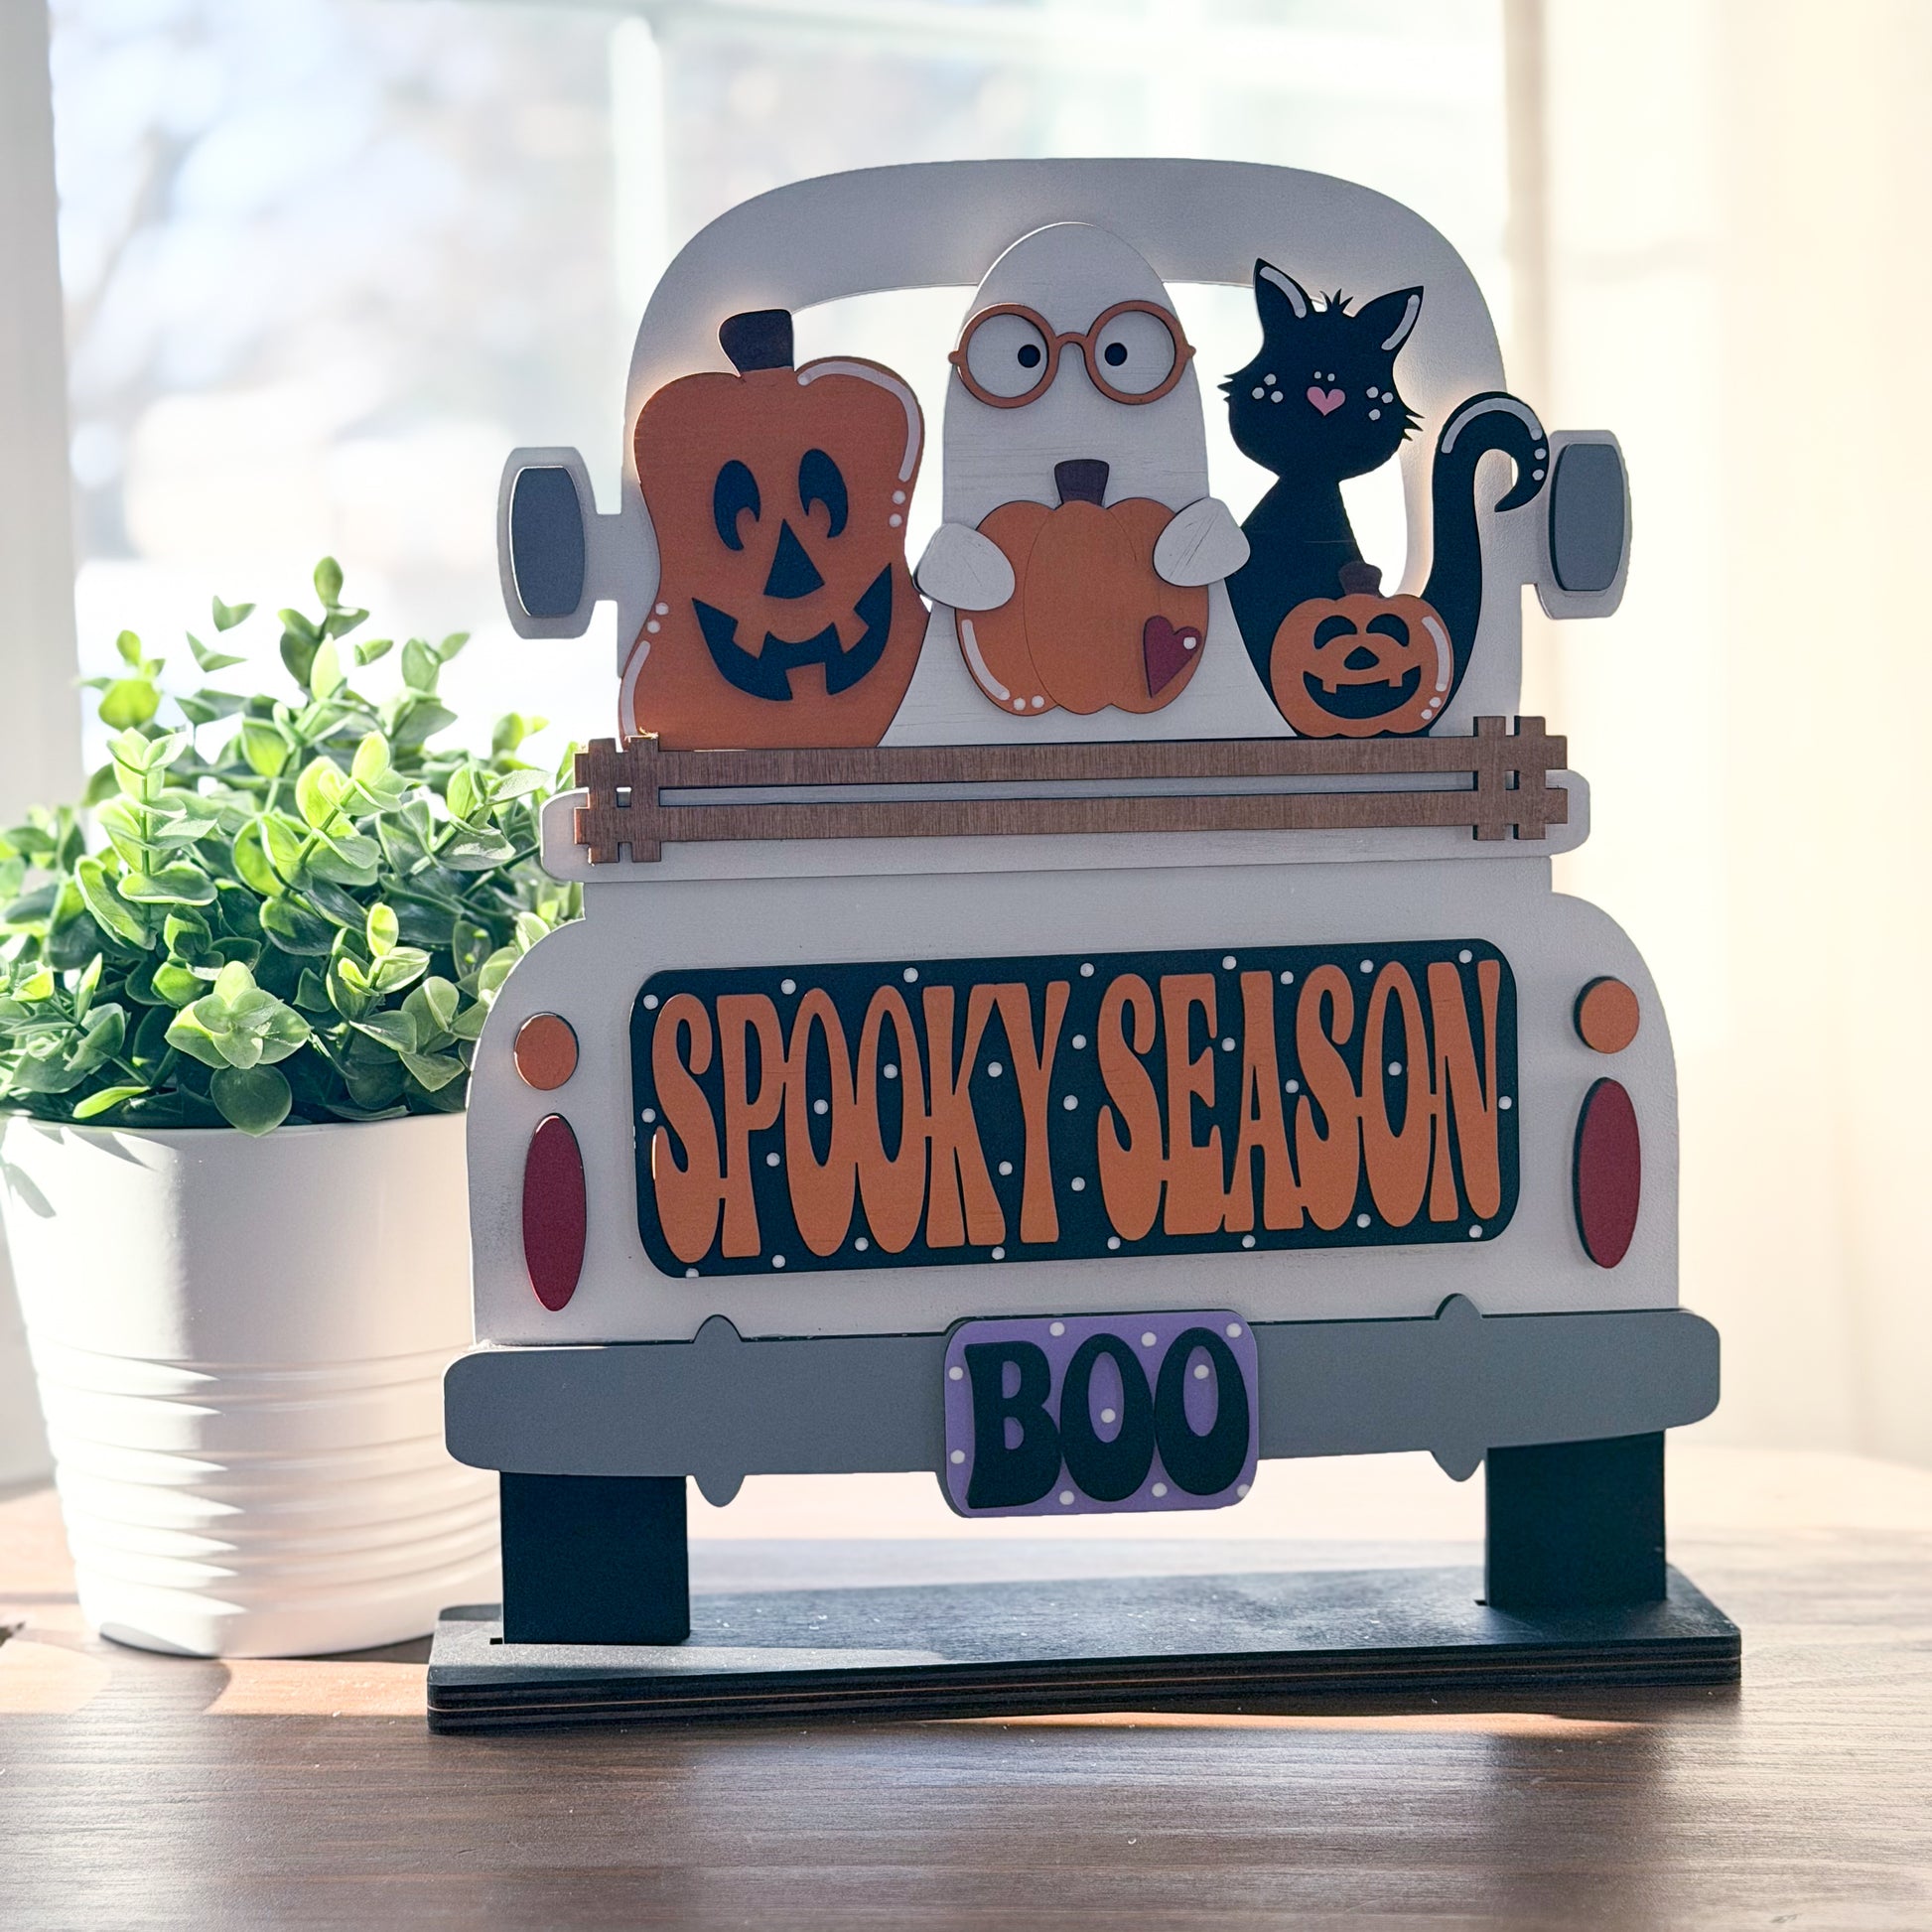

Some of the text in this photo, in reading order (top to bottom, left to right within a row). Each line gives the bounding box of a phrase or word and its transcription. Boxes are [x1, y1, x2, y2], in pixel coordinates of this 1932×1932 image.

[652, 960, 1500, 1263] SPOOKY SEASON
[964, 1326, 1250, 1509] BOO
